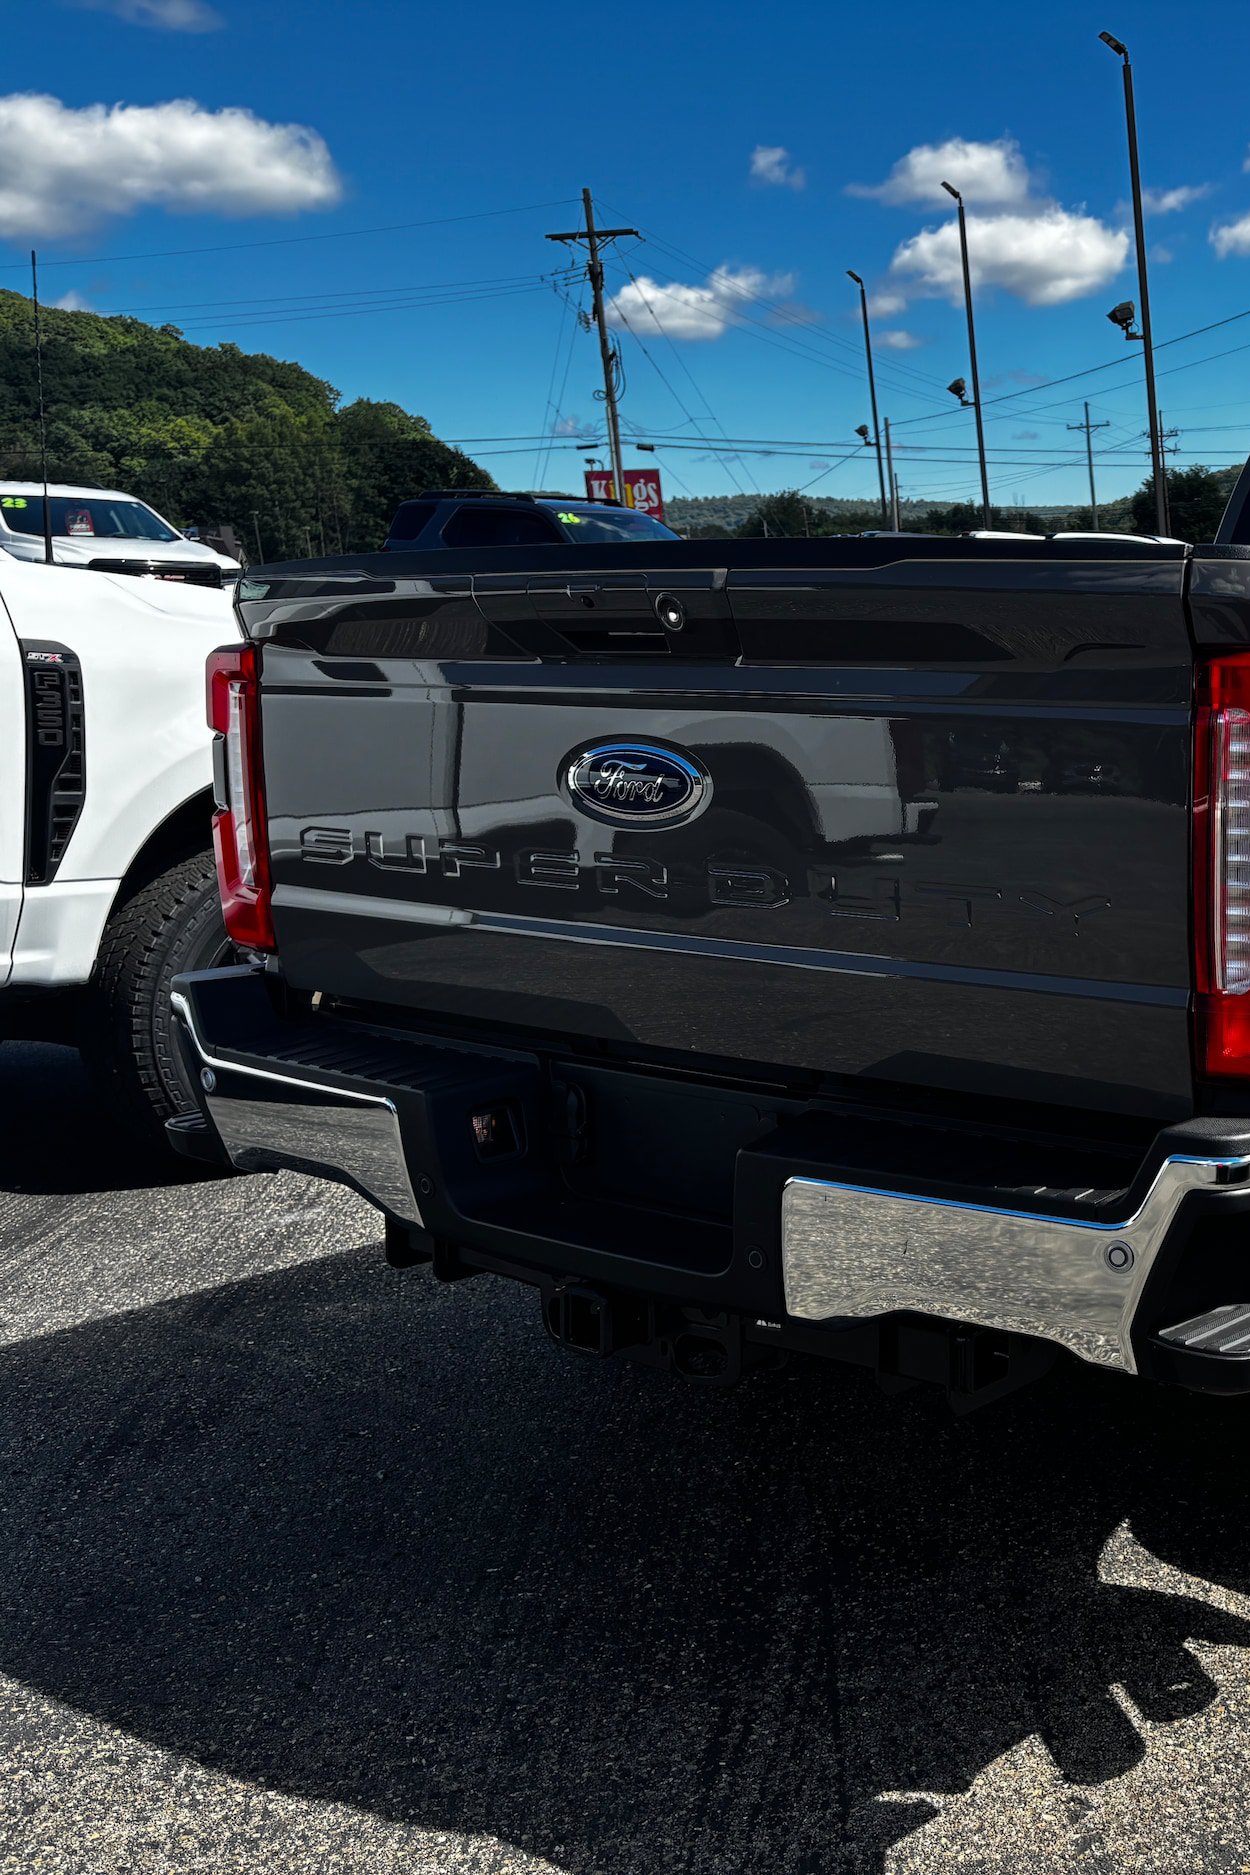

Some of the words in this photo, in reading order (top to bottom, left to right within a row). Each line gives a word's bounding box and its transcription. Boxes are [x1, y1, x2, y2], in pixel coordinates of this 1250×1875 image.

[1, 497, 28, 509] 23
[558, 512, 580, 523] 26
[594, 760, 665, 803] Ford
[300, 826, 669, 900] SUPER
[704, 860, 1112, 937] DUTY
